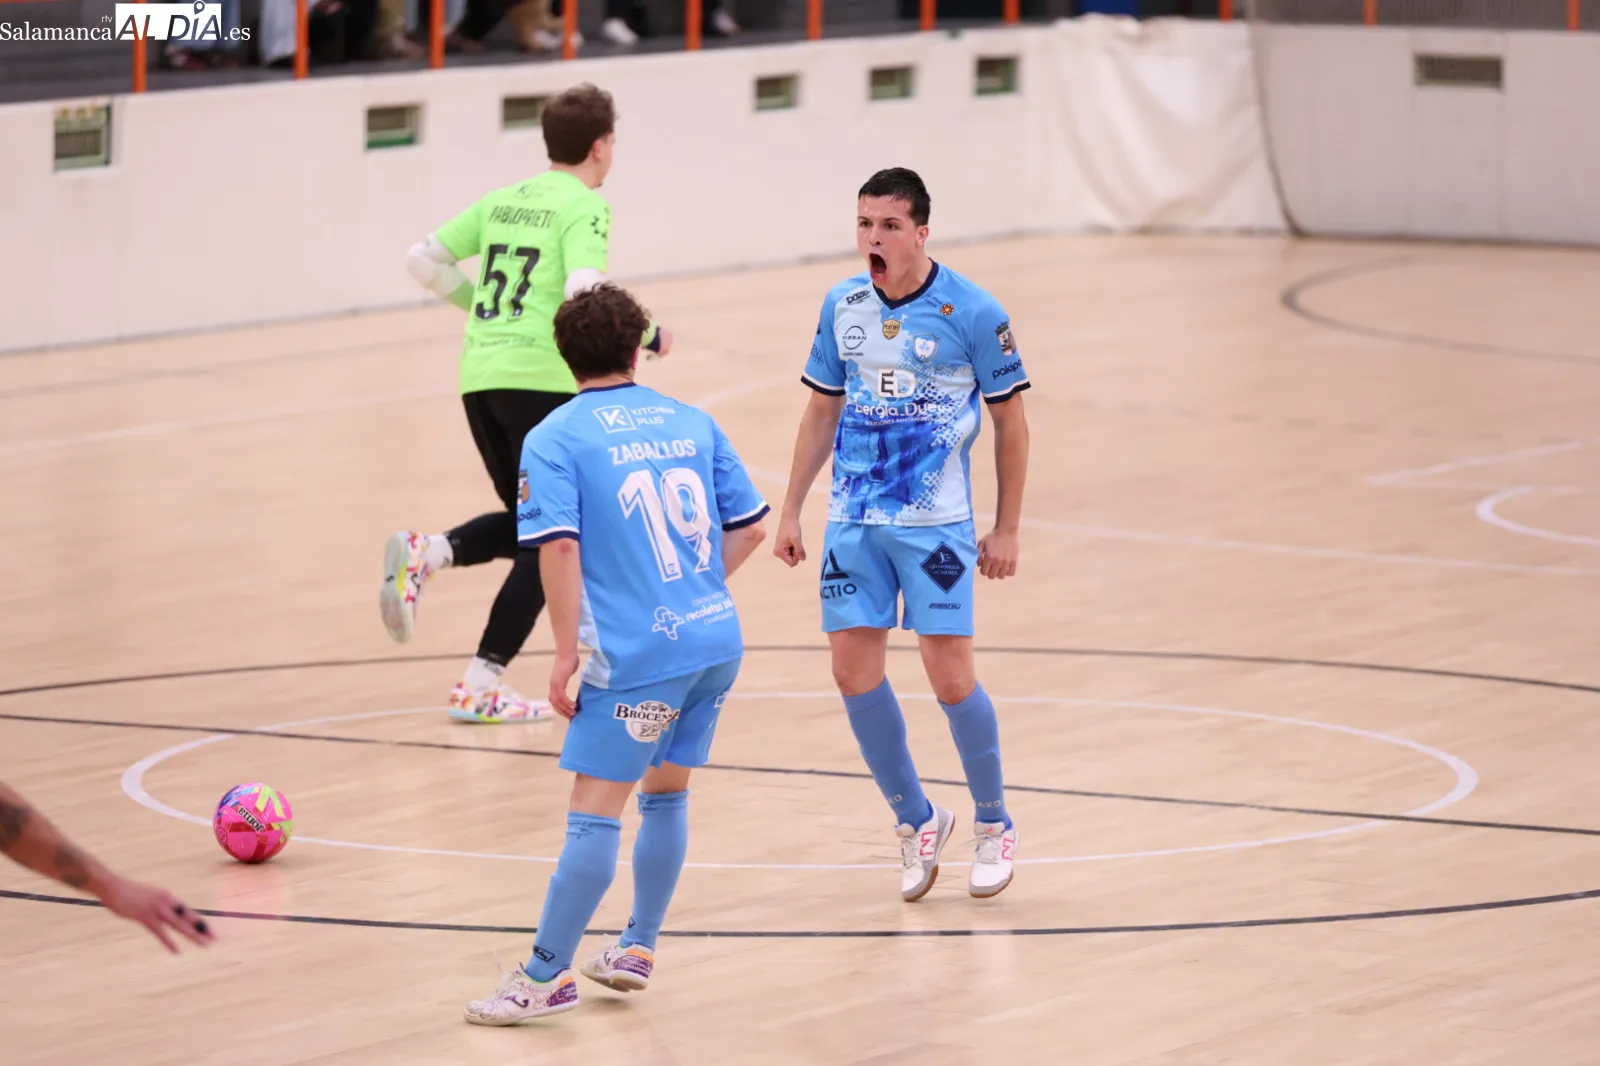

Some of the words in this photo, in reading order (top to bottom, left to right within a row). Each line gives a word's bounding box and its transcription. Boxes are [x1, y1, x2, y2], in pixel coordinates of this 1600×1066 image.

[475, 243, 541, 321] 57
[631, 406, 676, 416] KITCHEN
[636, 416, 665, 426] PLUS
[608, 438, 697, 466] ZABALLOS
[617, 467, 712, 583] 19
